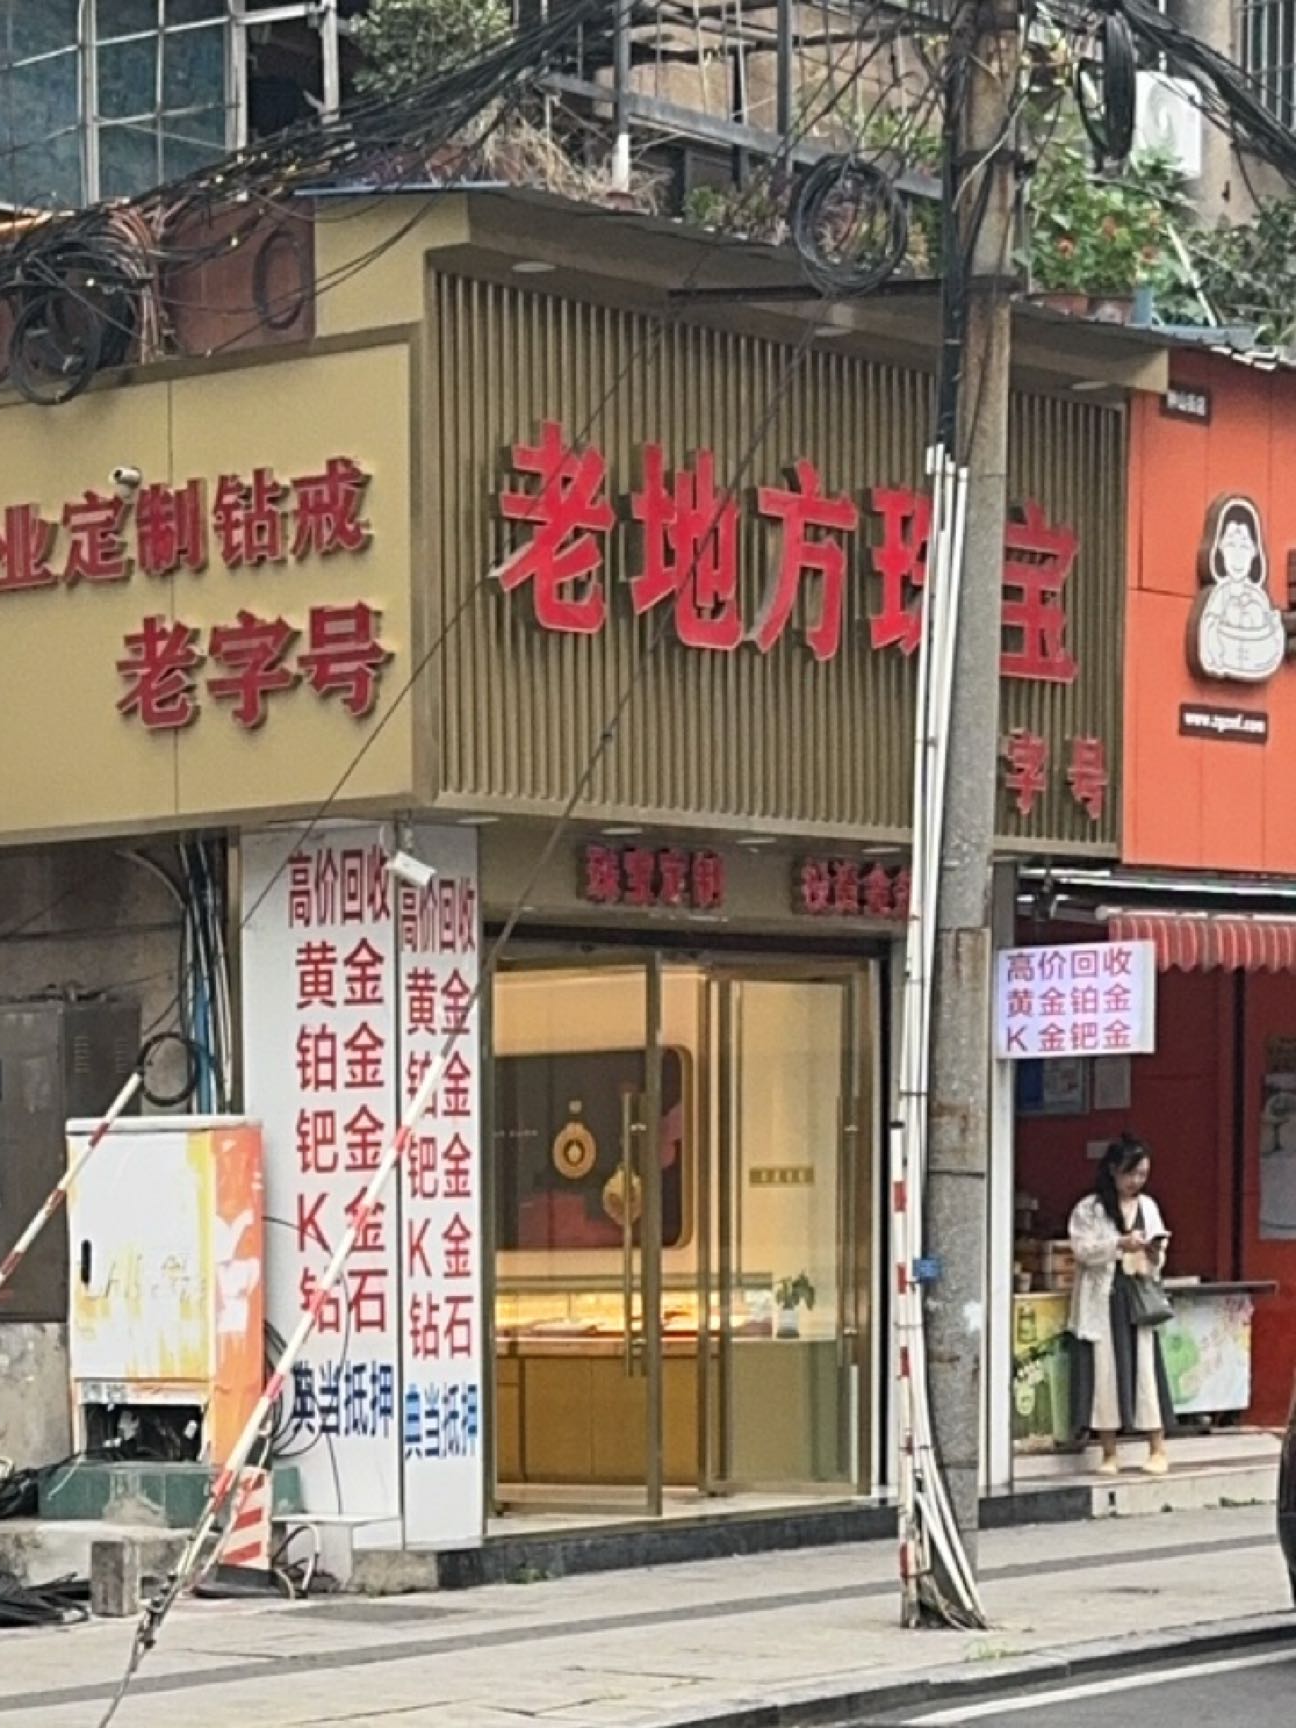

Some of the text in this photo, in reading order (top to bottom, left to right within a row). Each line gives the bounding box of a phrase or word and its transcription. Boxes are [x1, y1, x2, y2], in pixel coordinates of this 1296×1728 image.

[115, 601, 394, 730] 老字号
[288, 845, 391, 929] 高价回收
[400, 876, 476, 953] 高价回收
[295, 937, 385, 1008] 黄金
[405, 966, 471, 1036] 黄金
[1007, 948, 1132, 984] 高价回收
[296, 1021, 385, 1093] 铂金
[296, 1104, 385, 1174] 钯金
[407, 1132, 472, 1198] 钯金
[297, 1186, 385, 1253] K金
[409, 1212, 472, 1279] K金
[300, 1267, 389, 1334] 钻石
[409, 1293, 474, 1360] 钻石
[293, 1360, 395, 1439] 典当抵押
[405, 1383, 478, 1459] 典当抵押
